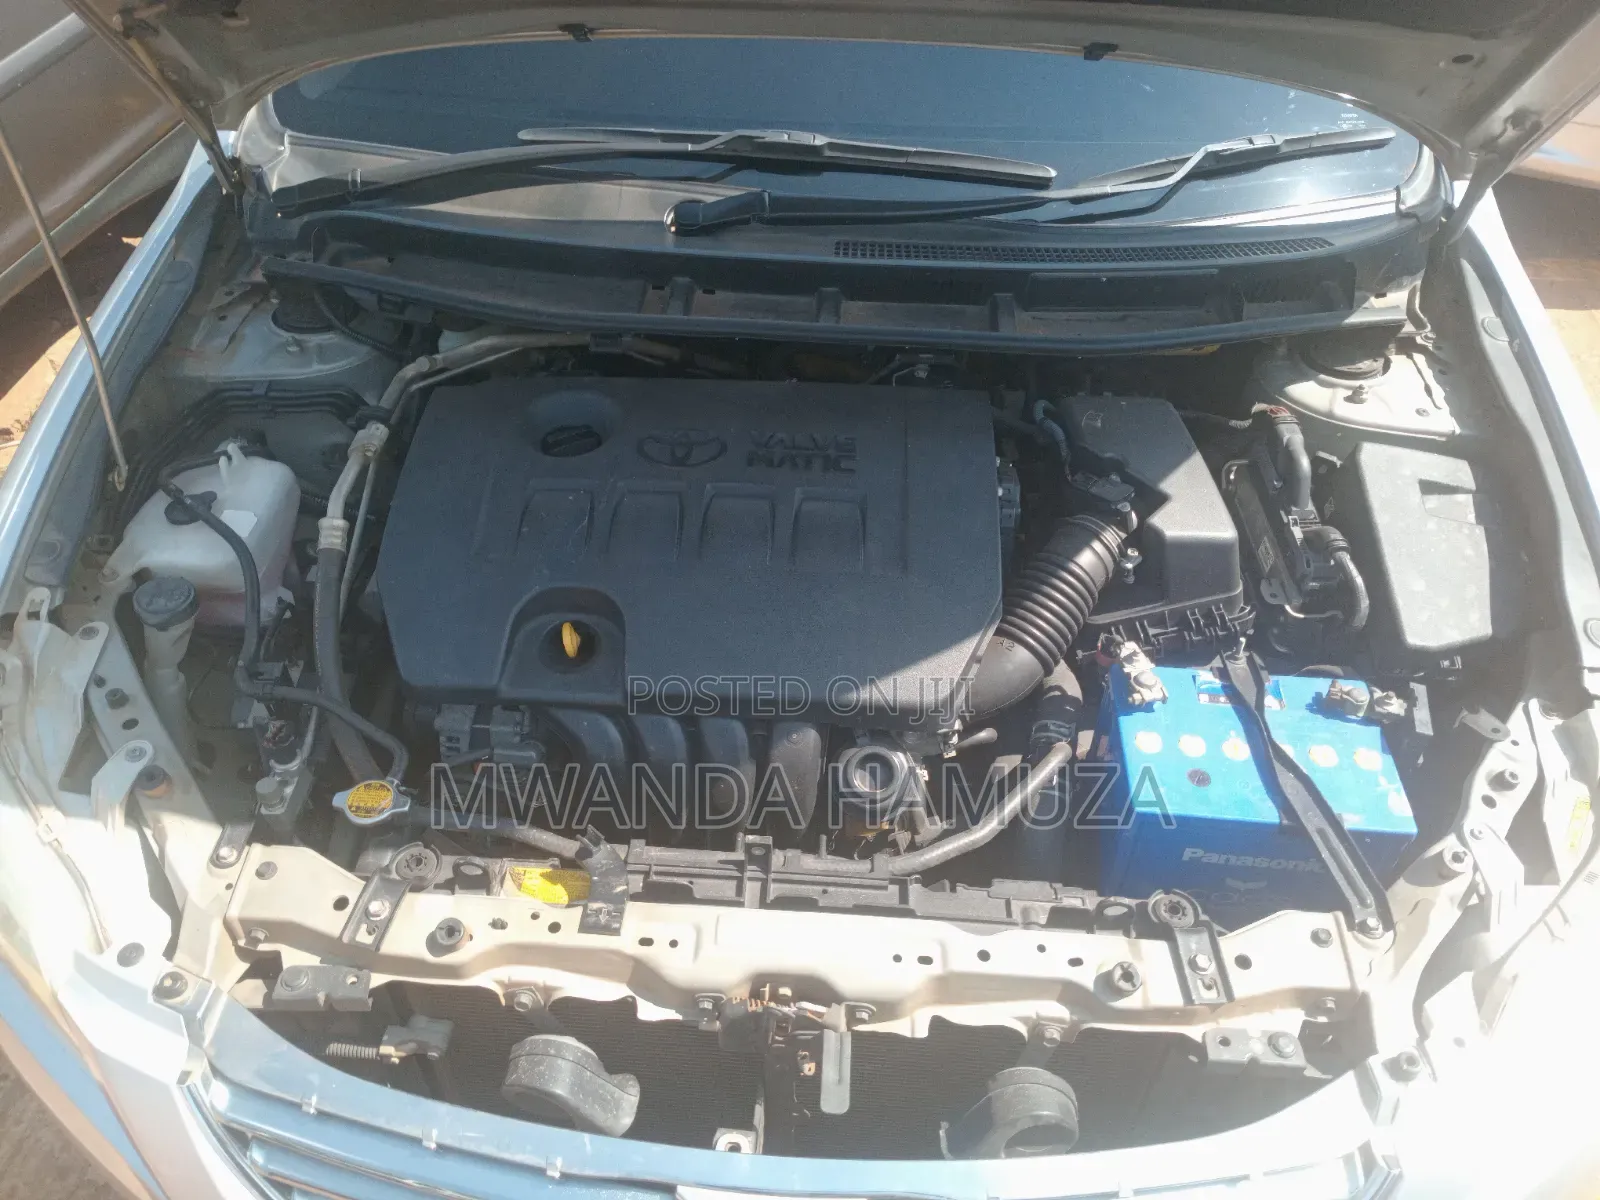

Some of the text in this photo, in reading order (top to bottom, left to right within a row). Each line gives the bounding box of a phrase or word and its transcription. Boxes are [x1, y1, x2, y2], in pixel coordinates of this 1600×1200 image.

[748, 429, 857, 452] VALVE
[746, 450, 857, 474] MATIC
[1181, 847, 1326, 874] Panasonic
